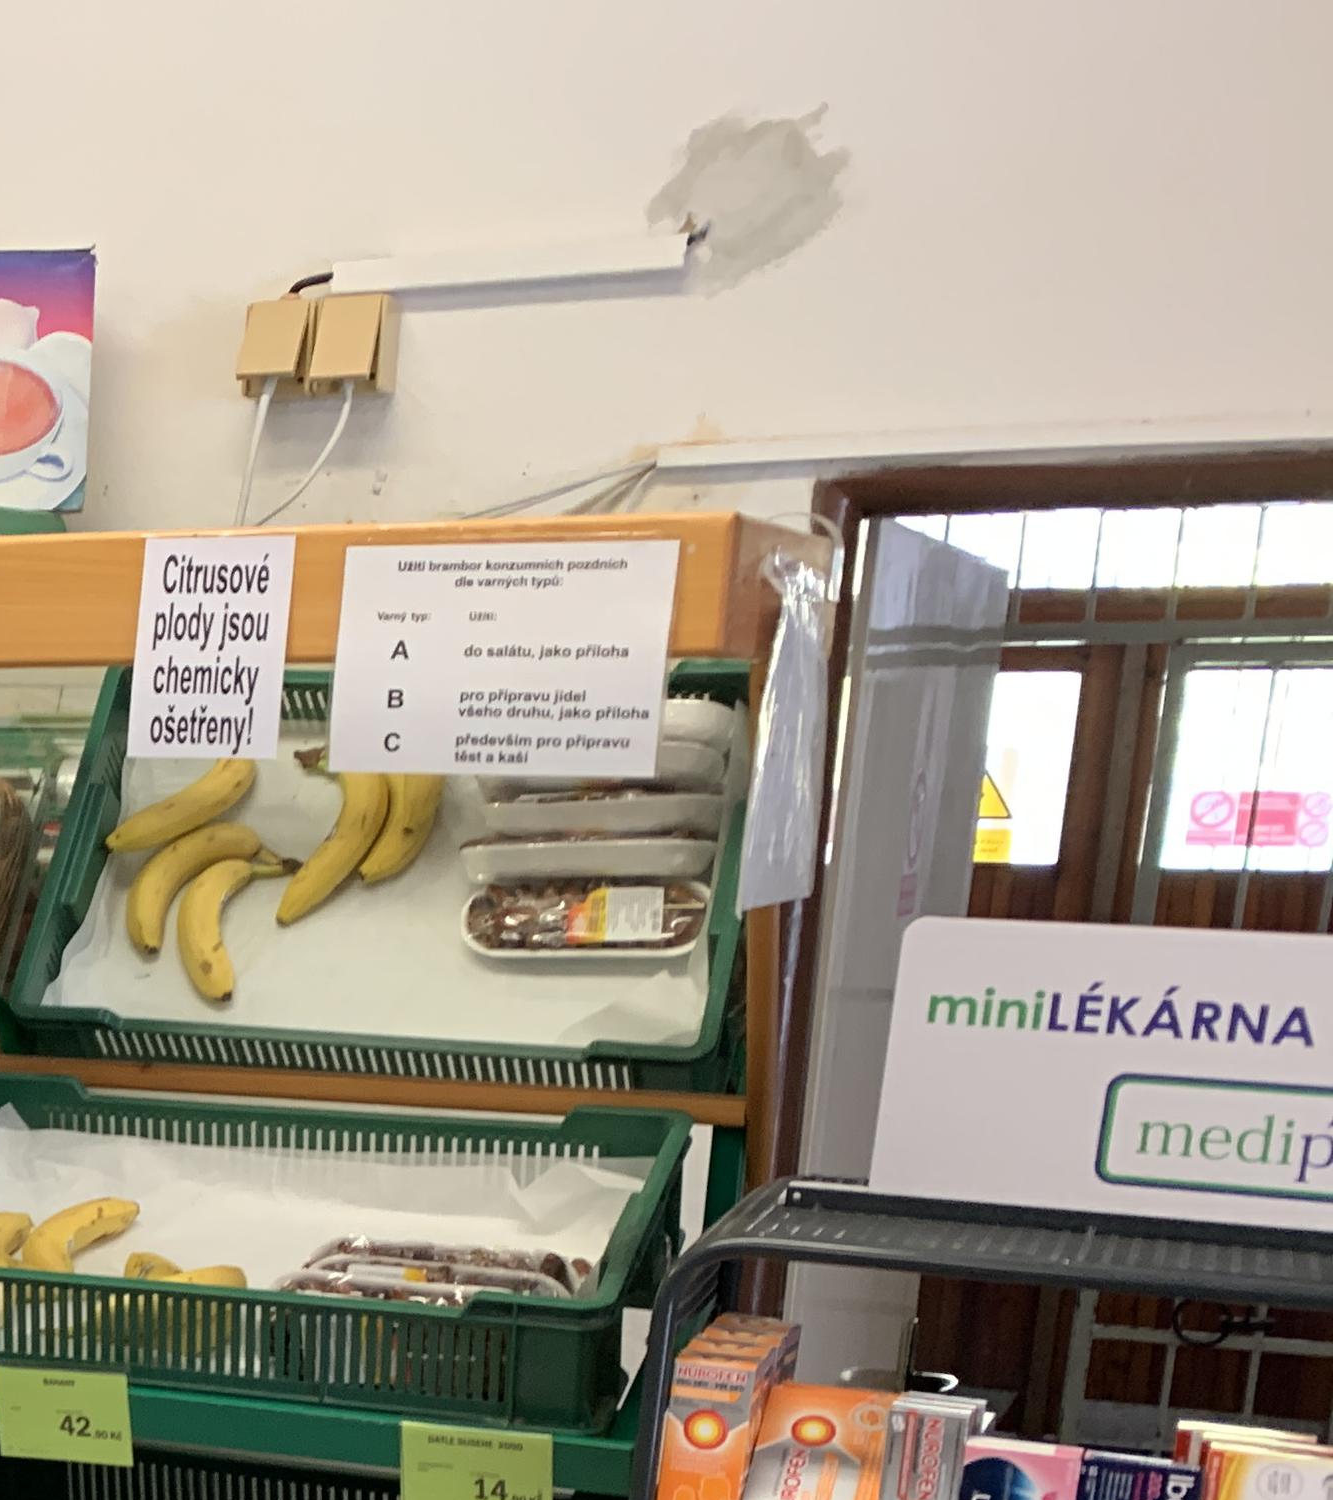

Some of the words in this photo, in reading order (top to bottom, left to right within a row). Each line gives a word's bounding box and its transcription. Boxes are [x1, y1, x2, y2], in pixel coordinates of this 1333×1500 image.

[163, 553, 270, 594] Citrusové
[429, 560, 482, 572] brambor
[454, 576, 474, 588] dle
[477, 576, 528, 590] varných
[152, 602, 214, 651] plody
[218, 603, 269, 651] jsou
[390, 640, 409, 660] A
[464, 645, 483, 657] do
[486, 645, 535, 659] salátu,
[538, 645, 572, 660] jako
[575, 644, 629, 660] příloha
[153, 655, 259, 705] chemicky
[387, 689, 404, 708] B
[459, 692, 484, 705] pro
[458, 706, 503, 719] všeho
[507, 707, 555, 720] druhu,
[557, 708, 592, 722] jako
[595, 707, 650, 722] příloha
[150, 704, 254, 755] ošetřeny!
[383, 732, 401, 752] C
[536, 737, 562, 750] pro
[485, 754, 494, 763] a
[926, 981, 1315, 1048] miniLÉKÁRNA
[1135, 1112, 1333, 1183] medip
[677, 1366, 750, 1385] NUROFEN
